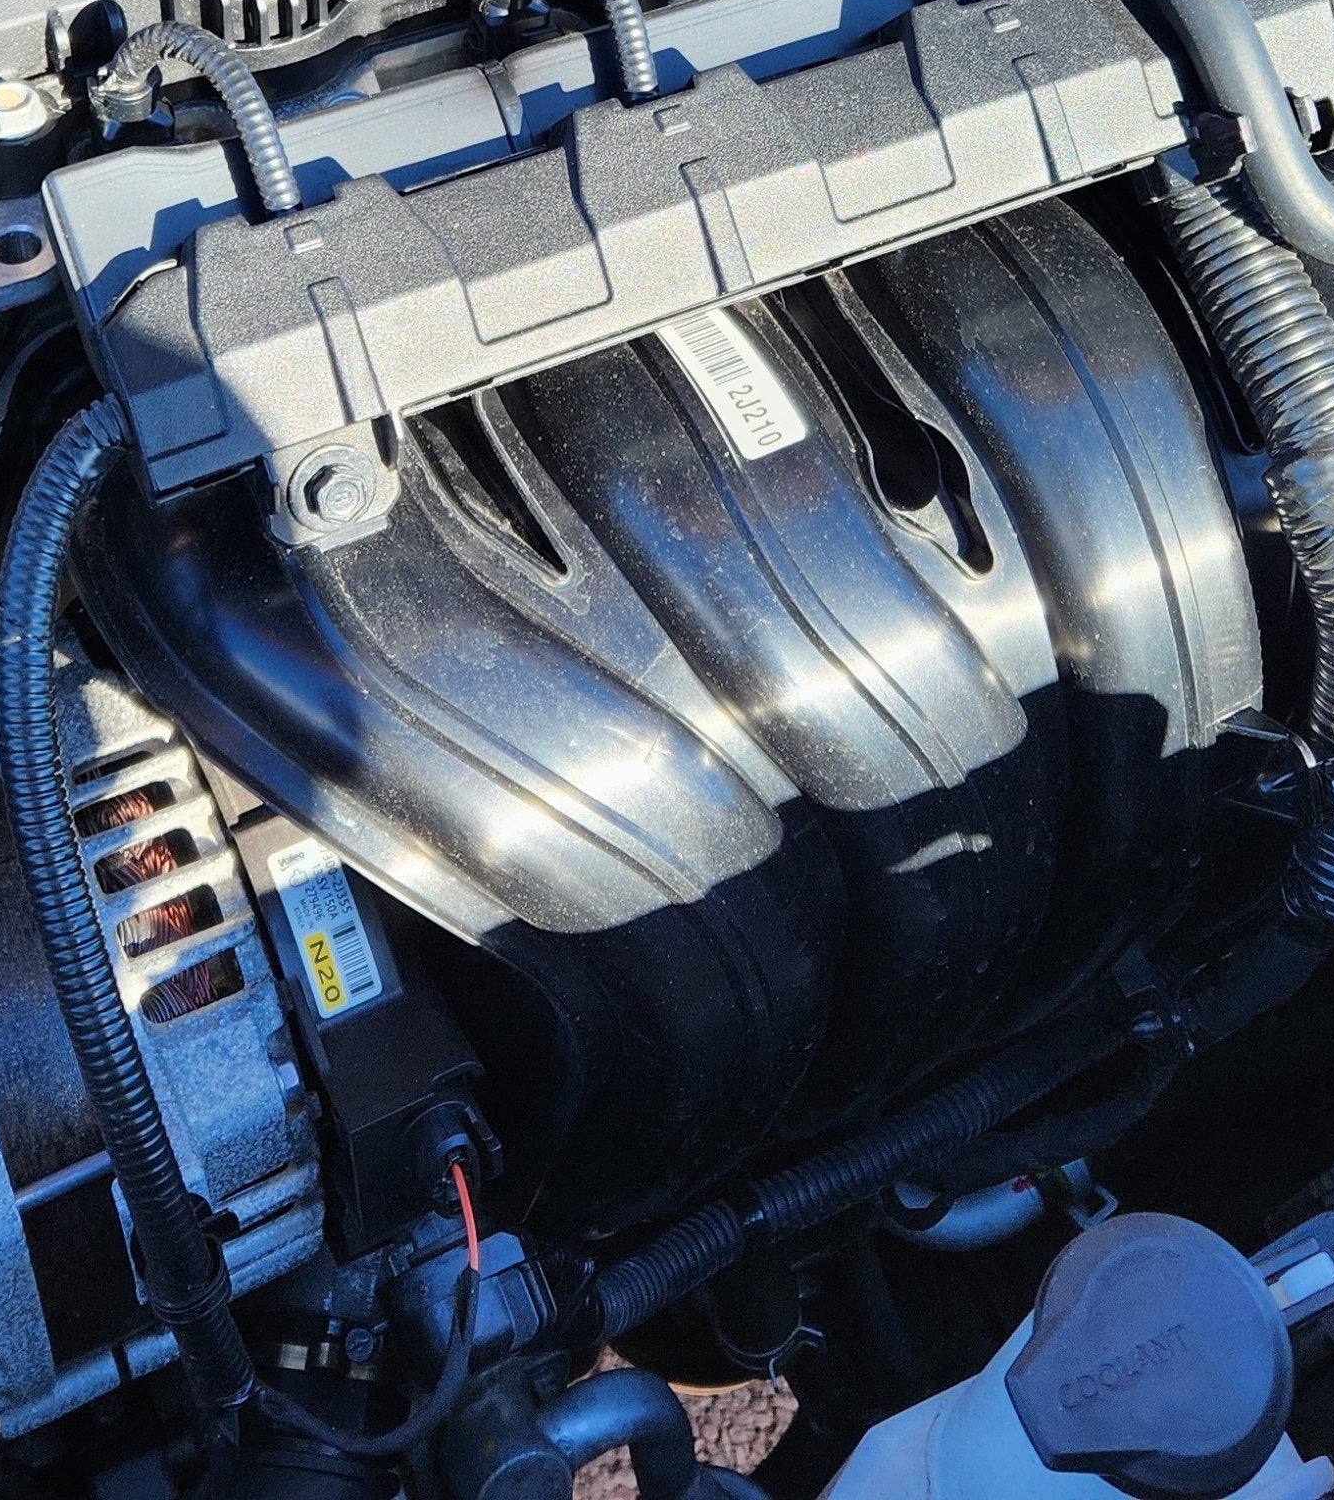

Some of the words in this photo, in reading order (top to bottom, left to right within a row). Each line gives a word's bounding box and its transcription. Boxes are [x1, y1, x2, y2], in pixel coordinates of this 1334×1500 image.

[727, 384, 782, 447] 2J210
[278, 851, 306, 868] Valeo
[303, 885, 325, 921] 279496
[324, 890, 339, 921] 150A
[309, 939, 342, 1003] N20
[1058, 1322, 1188, 1412] COOLANT
